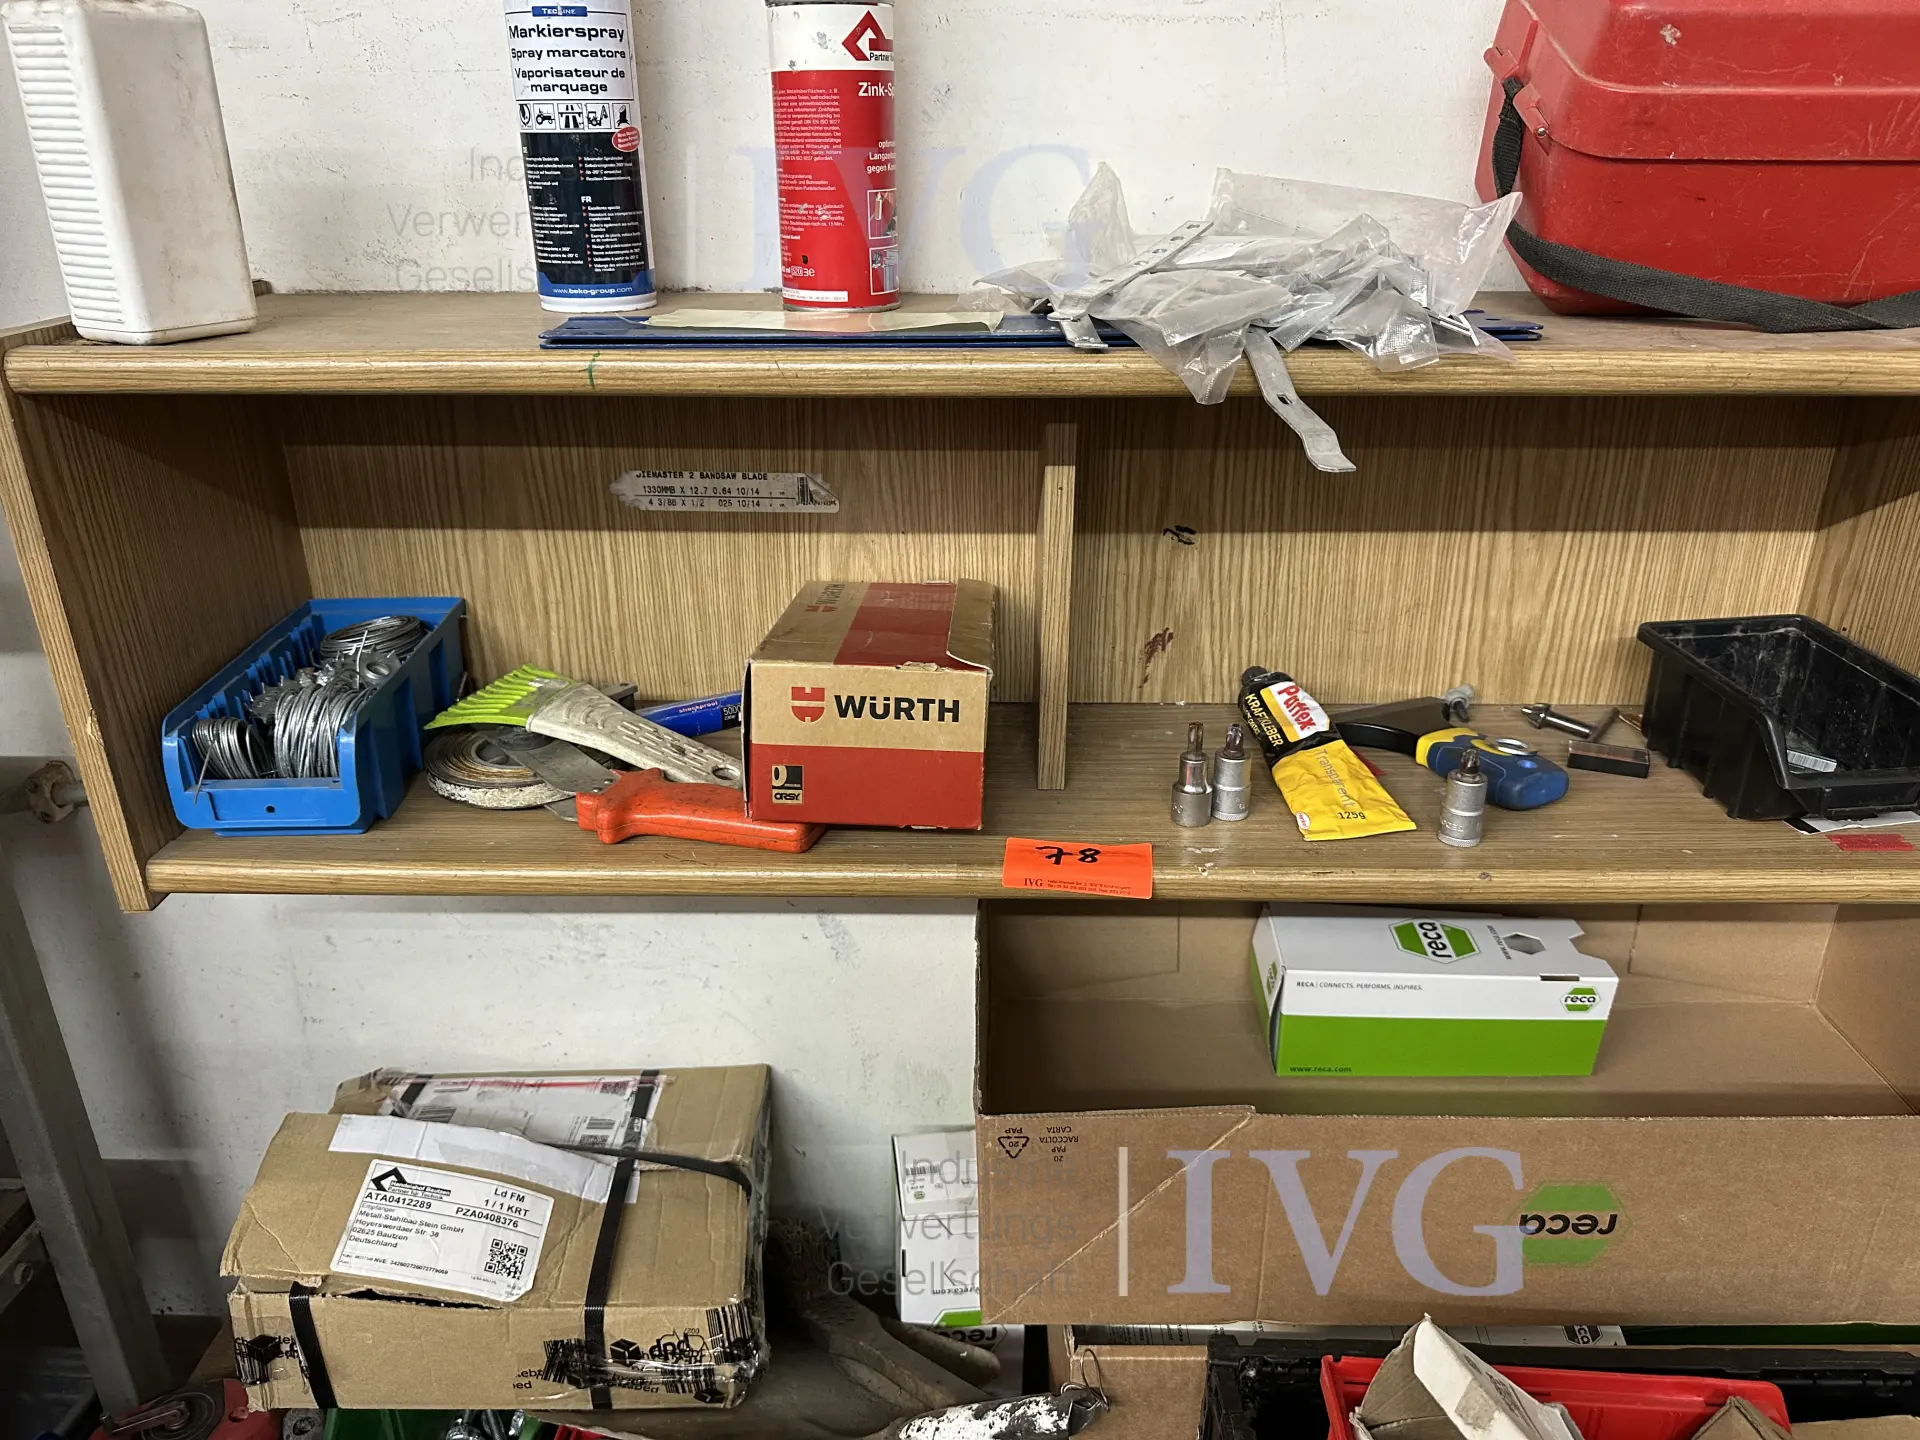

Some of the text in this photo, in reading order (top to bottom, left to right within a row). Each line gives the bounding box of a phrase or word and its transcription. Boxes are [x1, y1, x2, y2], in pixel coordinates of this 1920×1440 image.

[508, 24, 624, 42] Markierspray
[511, 48, 626, 61] Spray marcatore
[514, 67, 626, 80] Vaporisateur de
[530, 83, 608, 94] marquage
[552, 286, 632, 295] www.beko-group.com
[688, 471, 694, 479] 2
[700, 472, 737, 480] BANDSAW
[742, 472, 768, 480] BLADE
[680, 486, 685, 494] X
[690, 486, 708, 494] 12.7
[712, 487, 732, 495] 0.64
[736, 488, 760, 496] 10/14
[691, 499, 704, 507] 1/2
[736, 500, 760, 508] 10/14
[678, 701, 718, 713] shockproof
[834, 694, 960, 722] WÜRTH
[1314, 748, 1356, 809] Transparent
[774, 792, 800, 800] ORSY
[1338, 811, 1366, 820] 125g
[1024, 878, 1044, 887] IVG
[1418, 921, 1453, 959] reca
[1564, 994, 1597, 1004] reca
[1290, 1066, 1352, 1074] www.reca.com
[388, 1186, 410, 1196] Partner
[494, 1187, 526, 1202] Ld FM
[364, 1192, 432, 1210] ATA0412289
[498, 1202, 504, 1210] 1
[506, 1204, 530, 1217] KRT
[358, 1210, 464, 1234] Metall-Stahlbau Stein GmbH
[456, 1206, 519, 1228] PZA0408376
[356, 1218, 412, 1234] Hoyerswerdaer
[1518, 1214, 1618, 1234] reca
[352, 1226, 408, 1241] 02625 Bautzen
[348, 1234, 398, 1248] Deutschland
